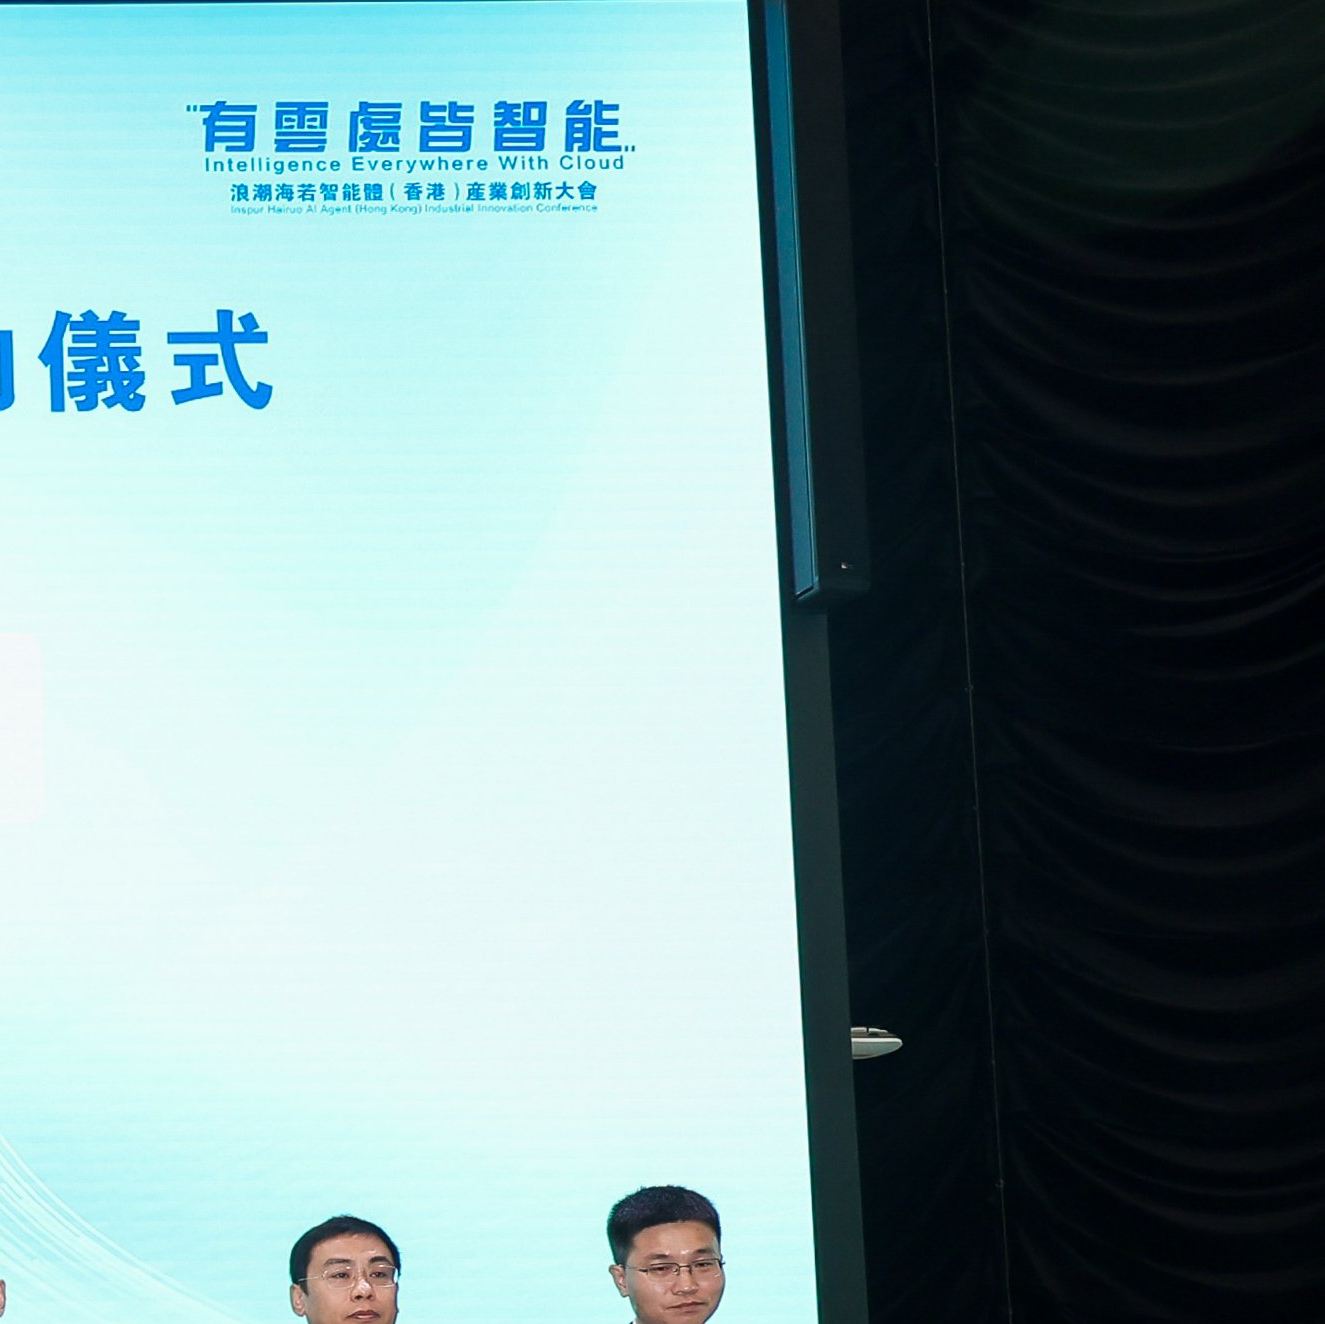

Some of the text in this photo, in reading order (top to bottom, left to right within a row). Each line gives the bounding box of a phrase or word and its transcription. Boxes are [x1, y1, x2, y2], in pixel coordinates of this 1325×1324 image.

[206, 155, 623, 174] Intelligence Everywhere With Cloud
[321, 204, 352, 216] Agent
[425, 203, 474, 213] Industrial
[478, 203, 533, 213] Innovation
[536, 203, 598, 213] Conference
